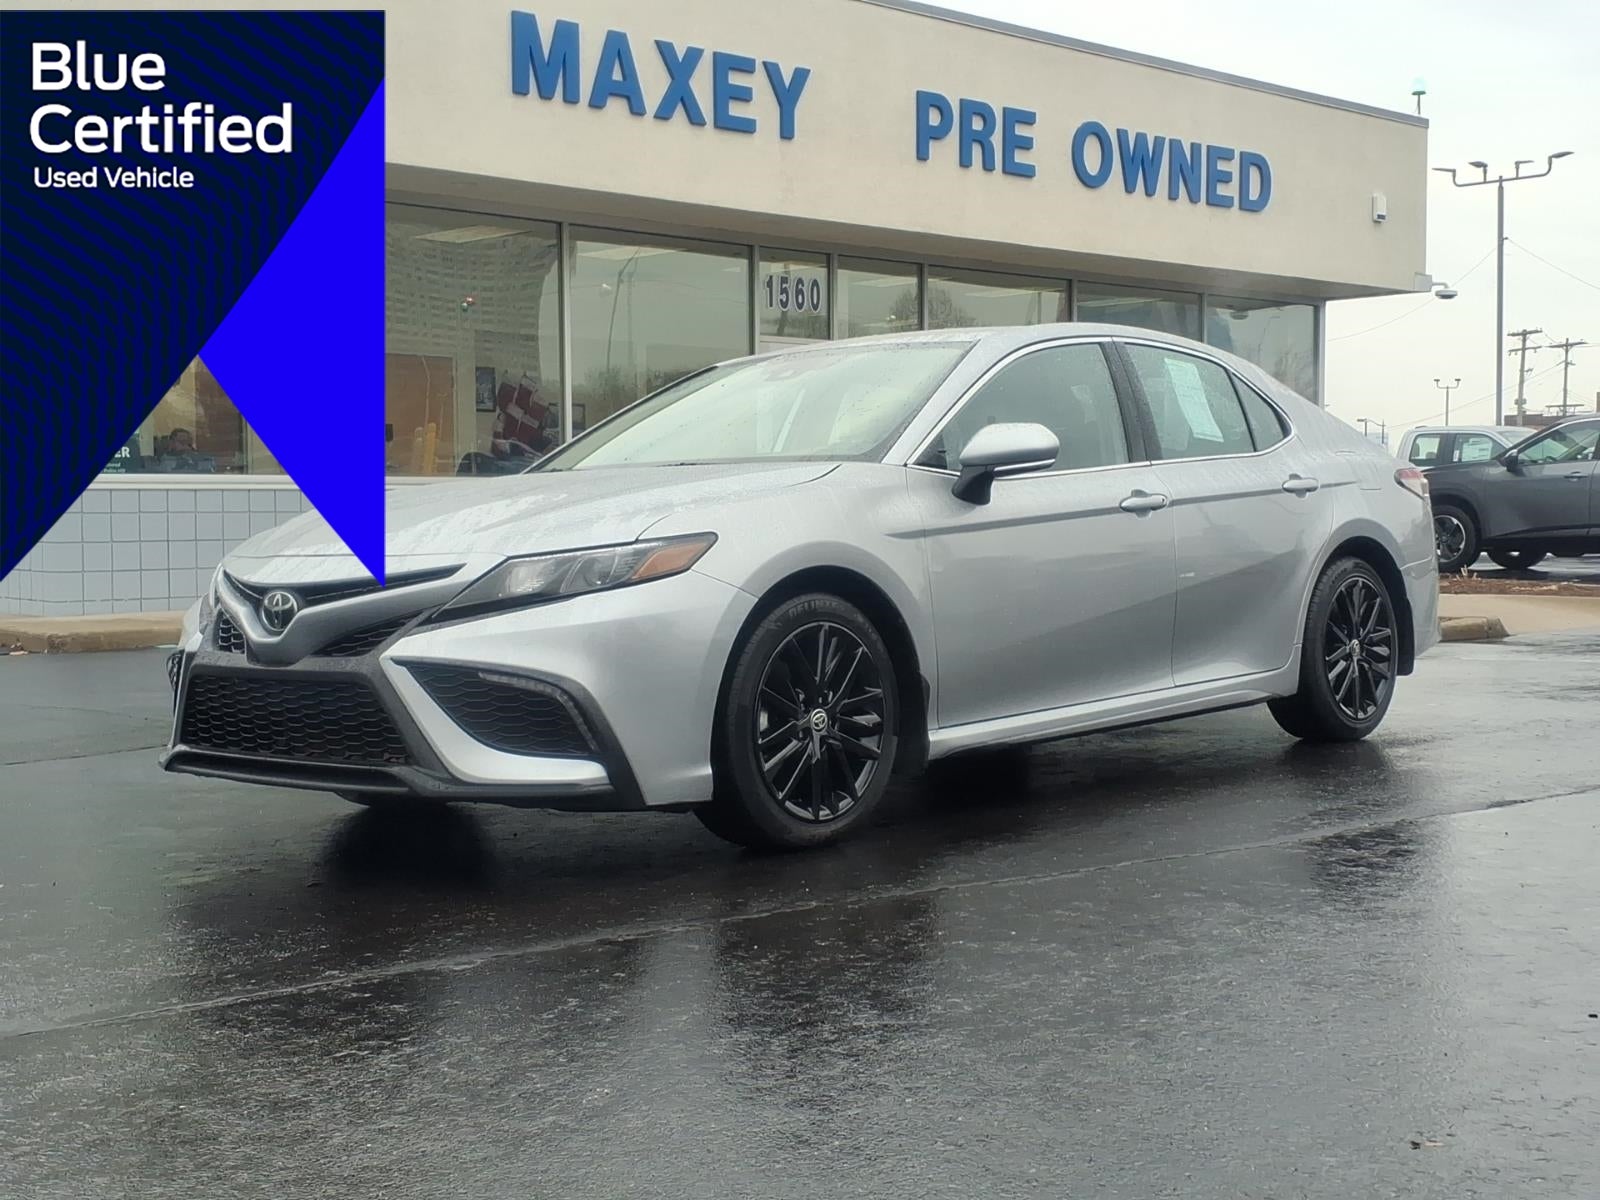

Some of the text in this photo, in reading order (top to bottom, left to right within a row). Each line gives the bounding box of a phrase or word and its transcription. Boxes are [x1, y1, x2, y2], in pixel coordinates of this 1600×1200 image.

[511, 10, 1272, 212] MAXEY PRE OWNED
[766, 274, 821, 312] 1560
